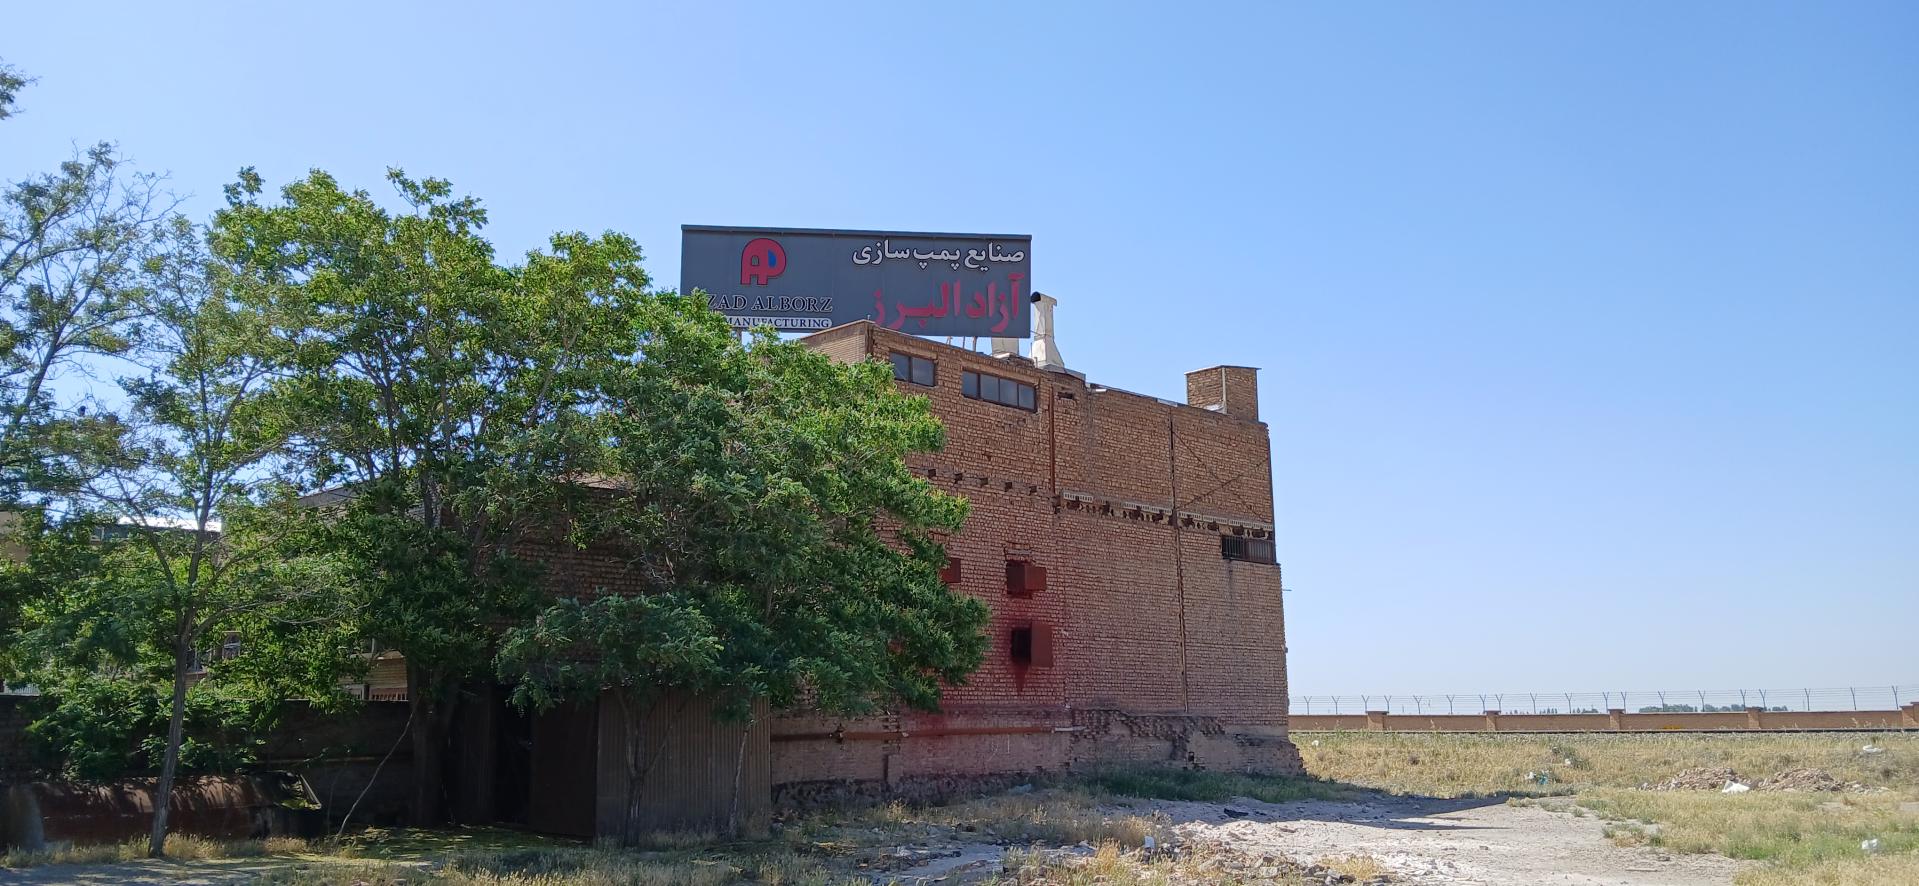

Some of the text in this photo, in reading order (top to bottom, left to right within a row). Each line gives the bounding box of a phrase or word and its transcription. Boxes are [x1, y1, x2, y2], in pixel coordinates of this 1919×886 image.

[963, 241, 1026, 272] صنایع
[706, 294, 834, 313] ZAD ALBORZ
[873, 272, 1025, 333] آزاد البرز
